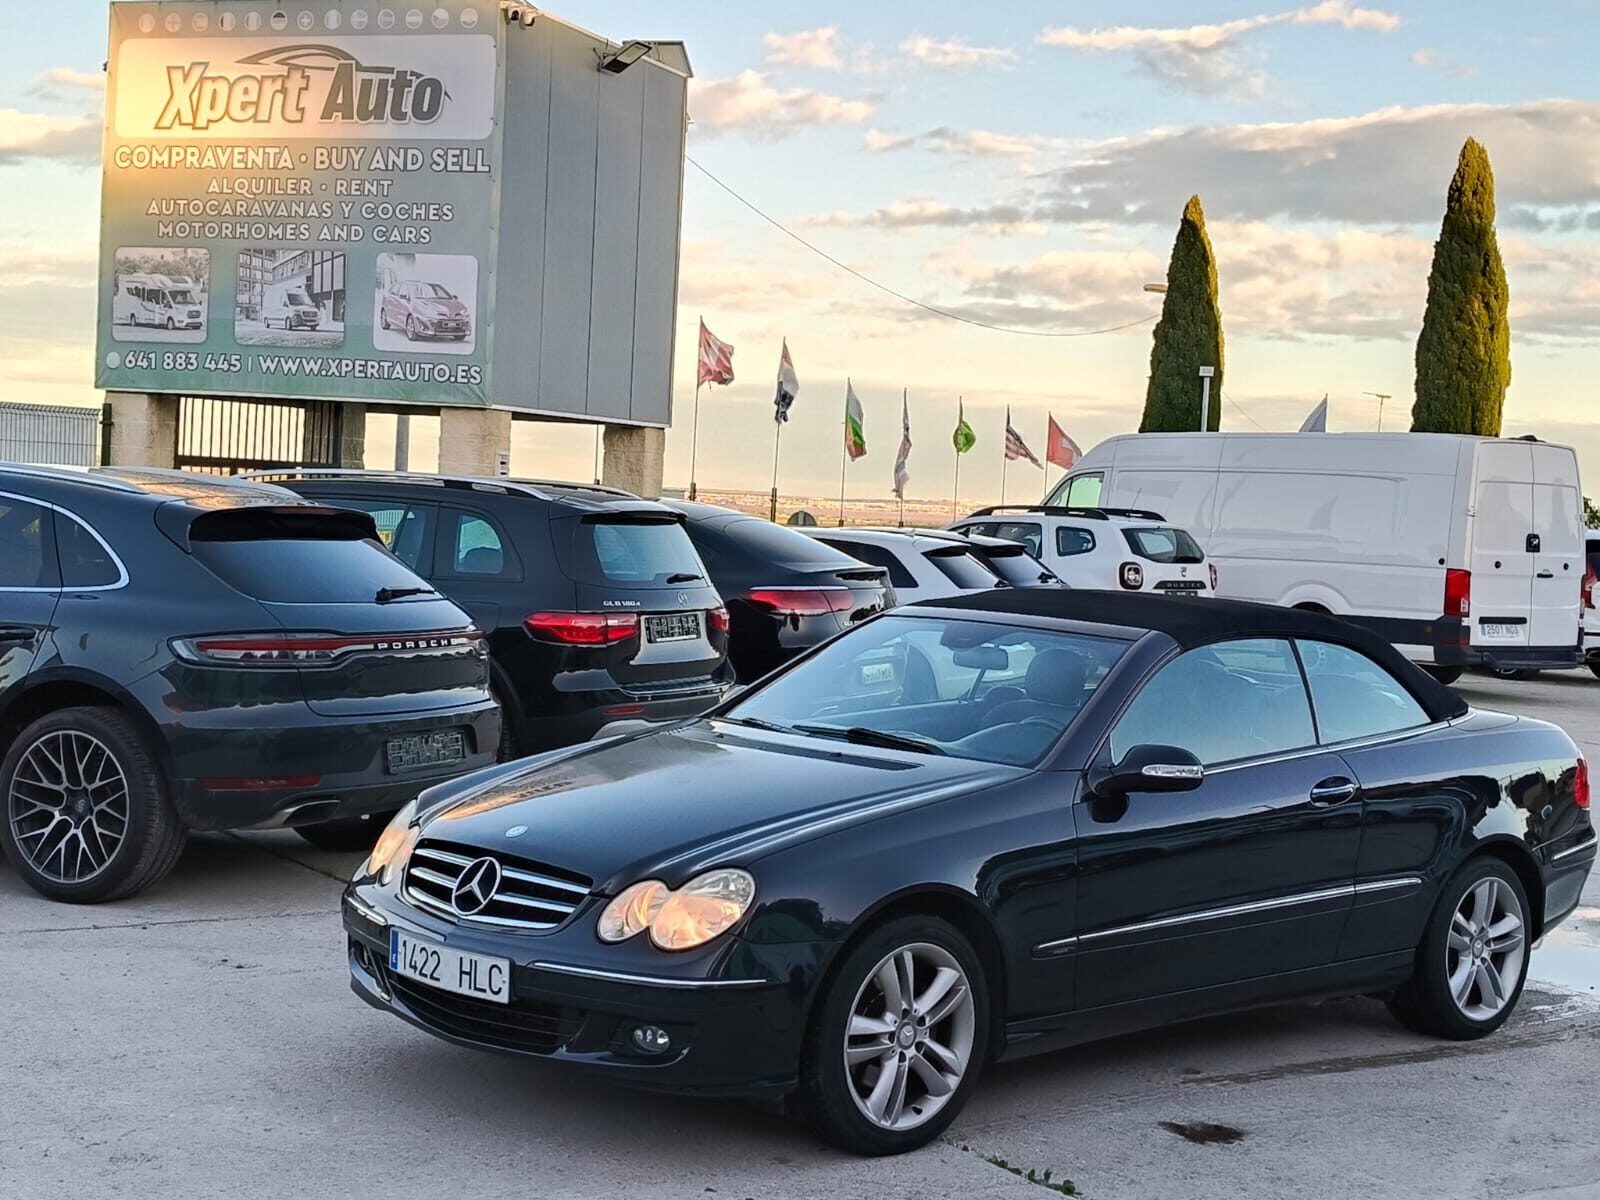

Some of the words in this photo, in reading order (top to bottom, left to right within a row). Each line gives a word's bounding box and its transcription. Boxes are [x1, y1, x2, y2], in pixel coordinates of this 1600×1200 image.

[153, 61, 310, 130] Xpert
[317, 59, 444, 124] Auto
[114, 146, 295, 170] COMPRAVENTA
[314, 147, 365, 171] BUY
[368, 147, 425, 172] AND
[430, 148, 491, 173] SELL
[207, 177, 313, 198] ALQUILER
[335, 179, 393, 197] RENT
[146, 199, 333, 219] AUTOCARAVANAS
[340, 202, 354, 219] Y
[360, 202, 455, 221] COCHES
[157, 221, 310, 240] MOTORHOMES
[317, 223, 365, 242] AND
[372, 225, 432, 244] CARS
[124, 350, 157, 370] 641
[162, 352, 199, 371] 883
[203, 353, 241, 373] 445
[257, 355, 483, 384] WWW.XPERTAUTO.ES
[378, 638, 460, 649] PORSCHE
[402, 939, 441, 982] 1422
[459, 956, 503, 995] HLC
